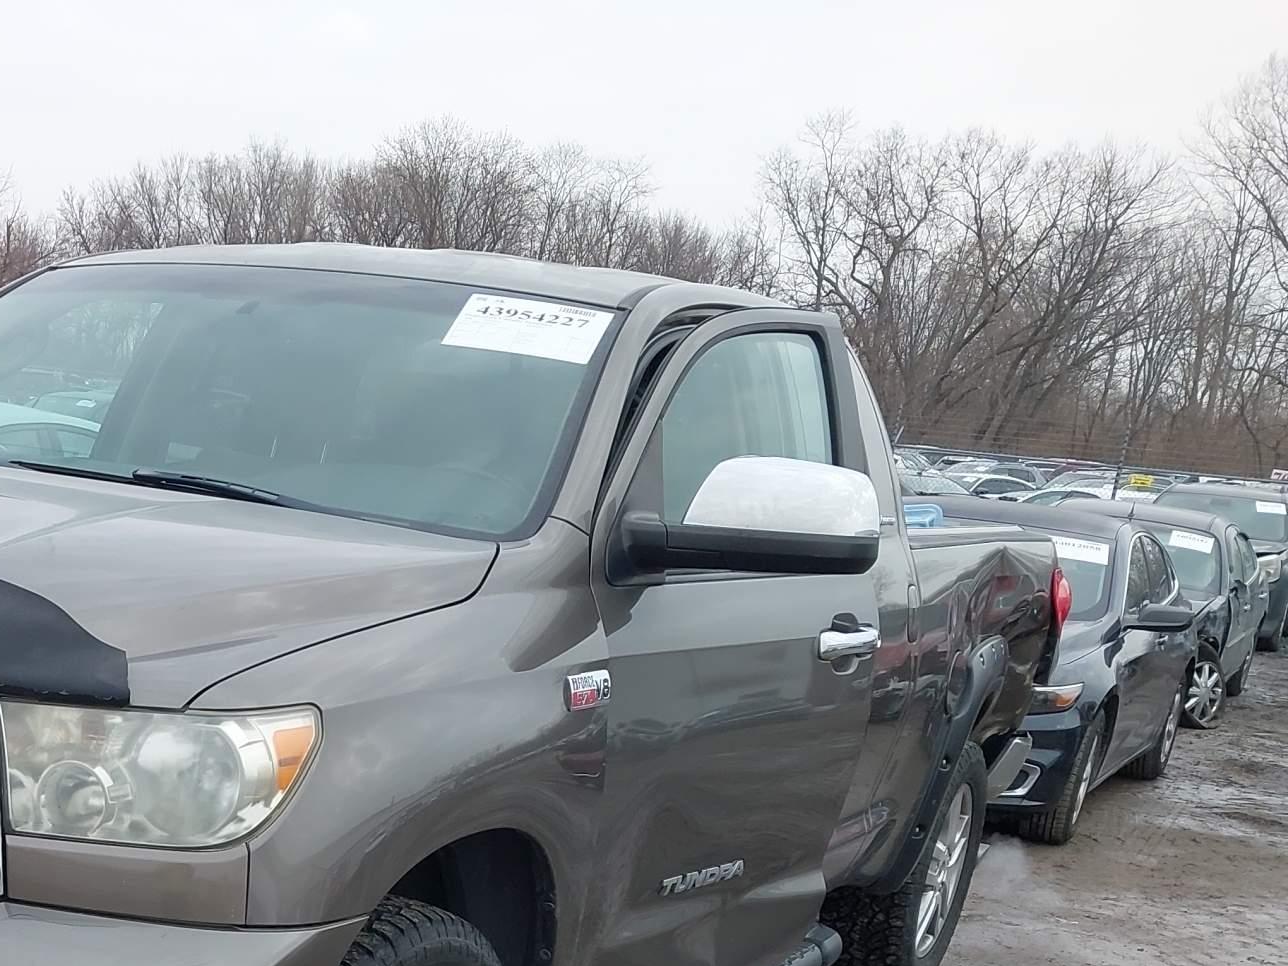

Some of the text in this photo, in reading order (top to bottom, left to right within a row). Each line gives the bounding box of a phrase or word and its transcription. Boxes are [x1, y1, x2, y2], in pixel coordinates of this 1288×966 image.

[475, 304, 590, 328] 43954227
[594, 677, 611, 700] V8
[662, 859, 744, 896] TUNDRA
